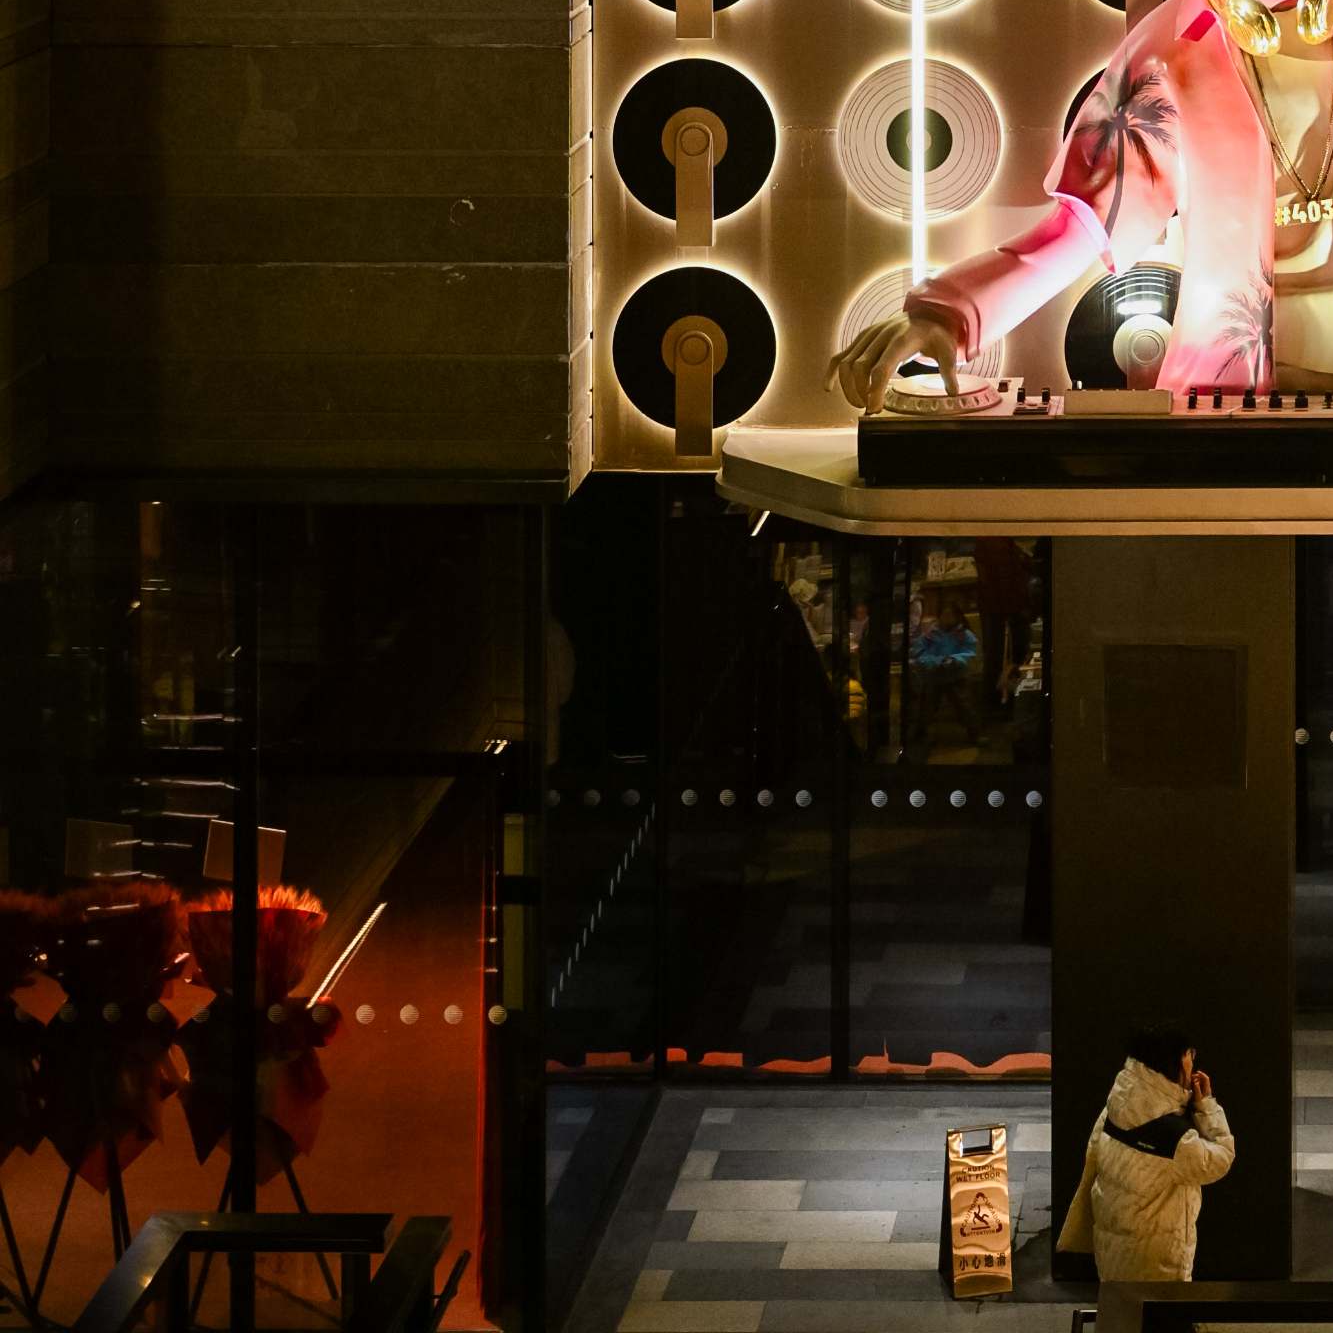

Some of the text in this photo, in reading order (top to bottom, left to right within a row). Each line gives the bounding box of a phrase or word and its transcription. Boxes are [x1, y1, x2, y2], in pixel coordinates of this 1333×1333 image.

[962, 1165, 995, 1173] CAUTION
[956, 1172, 1001, 1182] WET FLOOR
